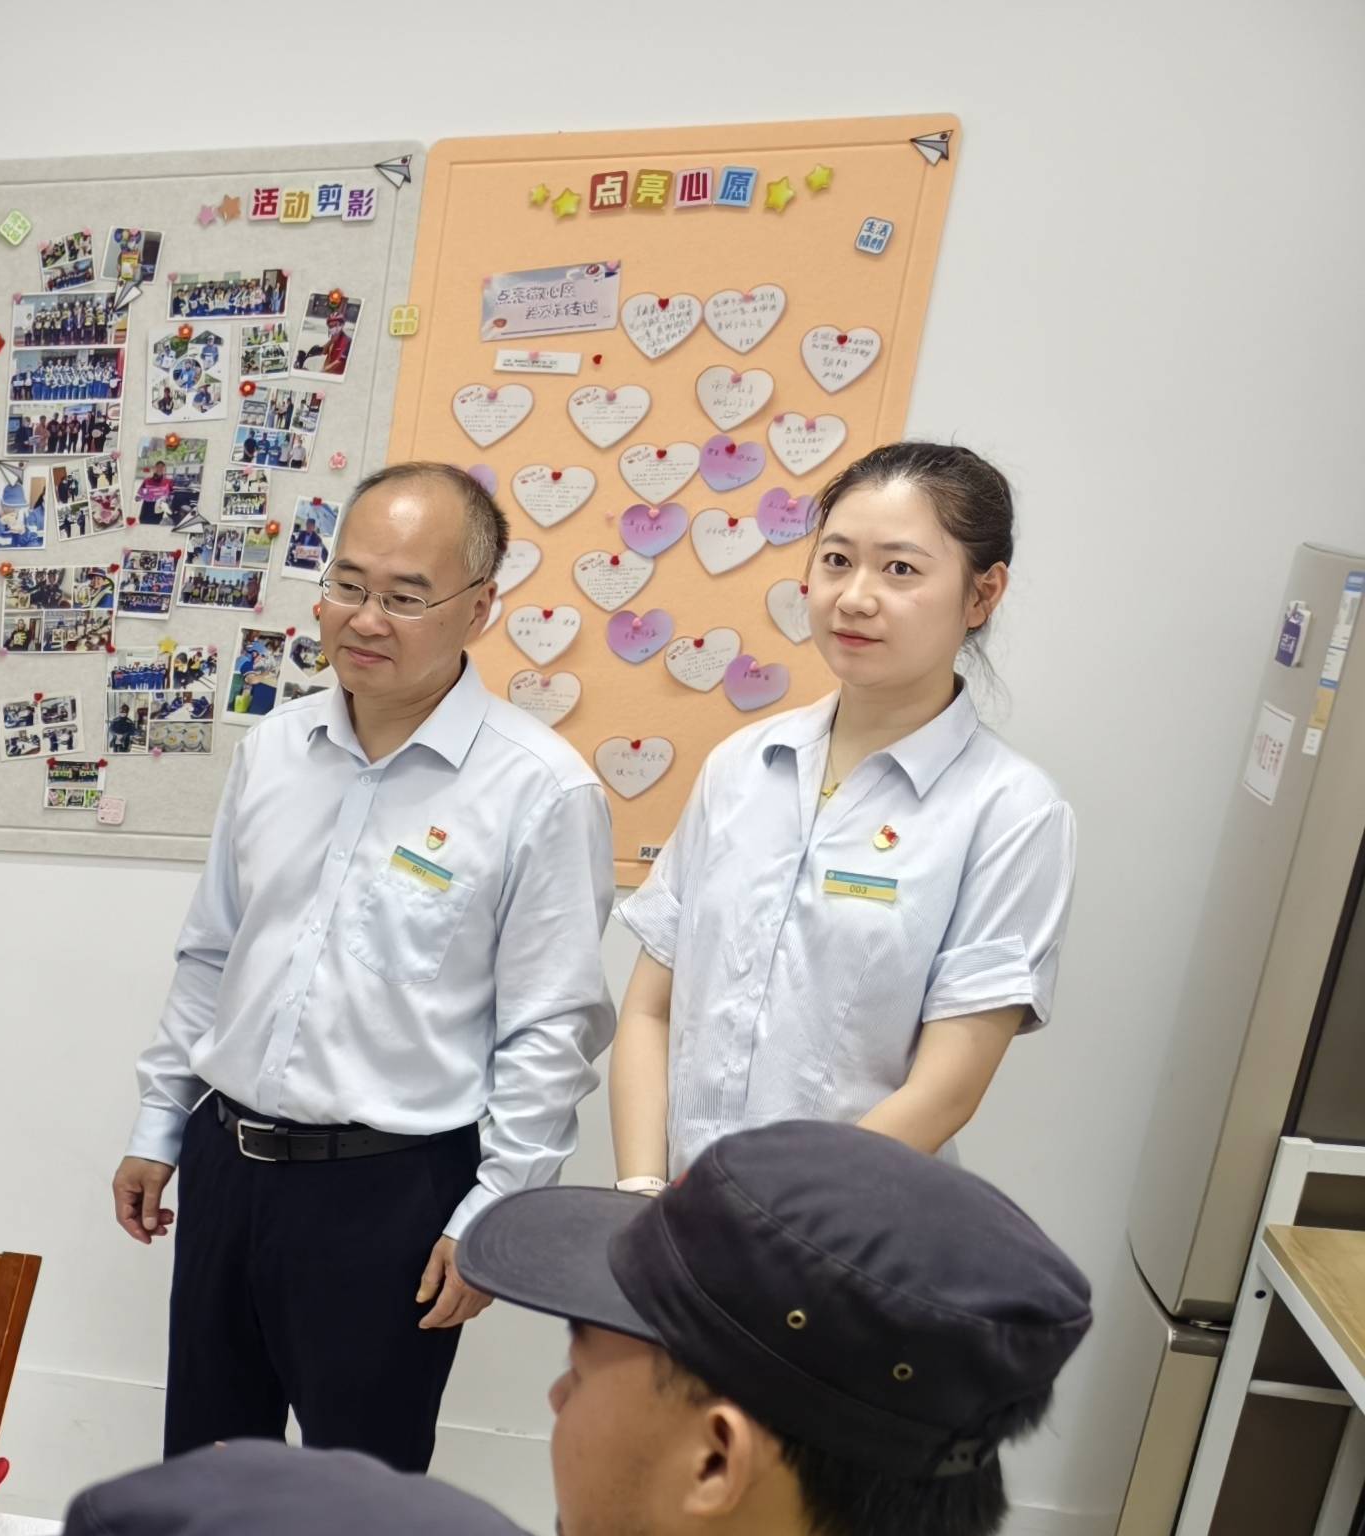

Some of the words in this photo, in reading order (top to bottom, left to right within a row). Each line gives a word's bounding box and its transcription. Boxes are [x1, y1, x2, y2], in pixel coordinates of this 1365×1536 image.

[252, 183, 374, 219] 活动剪影
[594, 171, 754, 207] 点亮心愿
